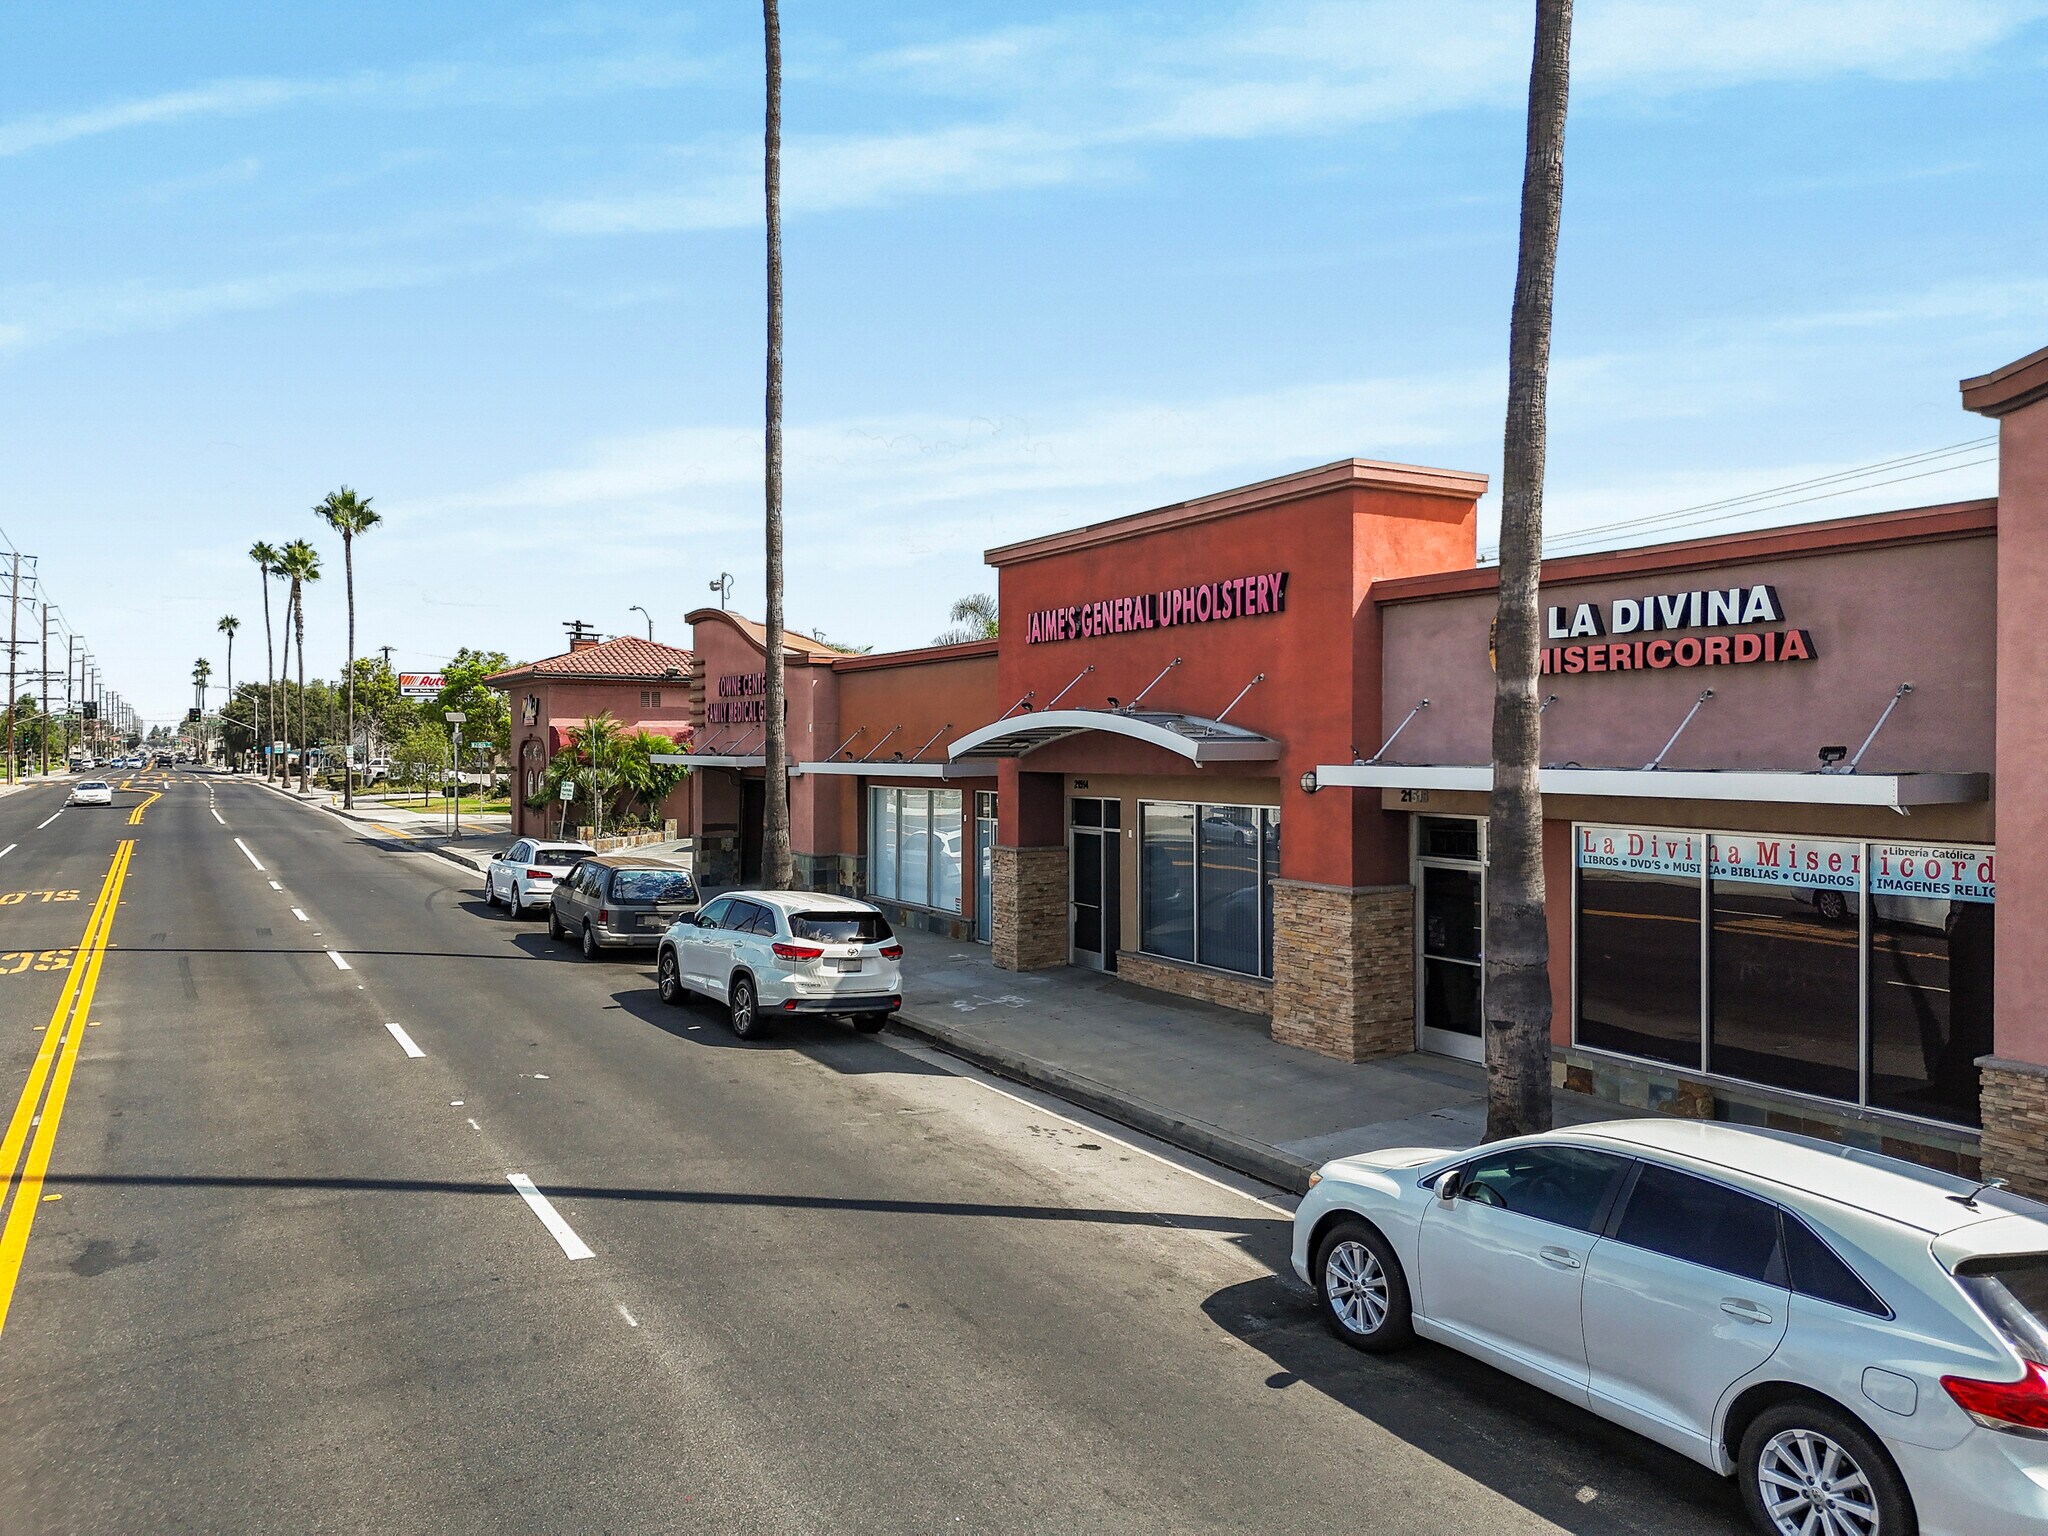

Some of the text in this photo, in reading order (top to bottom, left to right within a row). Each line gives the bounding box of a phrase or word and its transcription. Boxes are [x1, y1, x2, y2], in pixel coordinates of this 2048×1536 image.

[1025, 571, 1288, 644] JAIME'S GENERAL UPHOLSTERY
[1548, 584, 1784, 639] LA DIVINA
[743, 673, 766, 696] CENTE
[728, 701, 757, 723] MEDICAL
[1583, 831, 1615, 855] La
[1889, 847, 1975, 860] Librería Católica
[1583, 855, 1619, 866] LIBROS
[1730, 866, 1779, 880] BIBLIAS
[1792, 871, 1854, 887] CUADROS
[1876, 878, 1951, 894] IMAGENES
